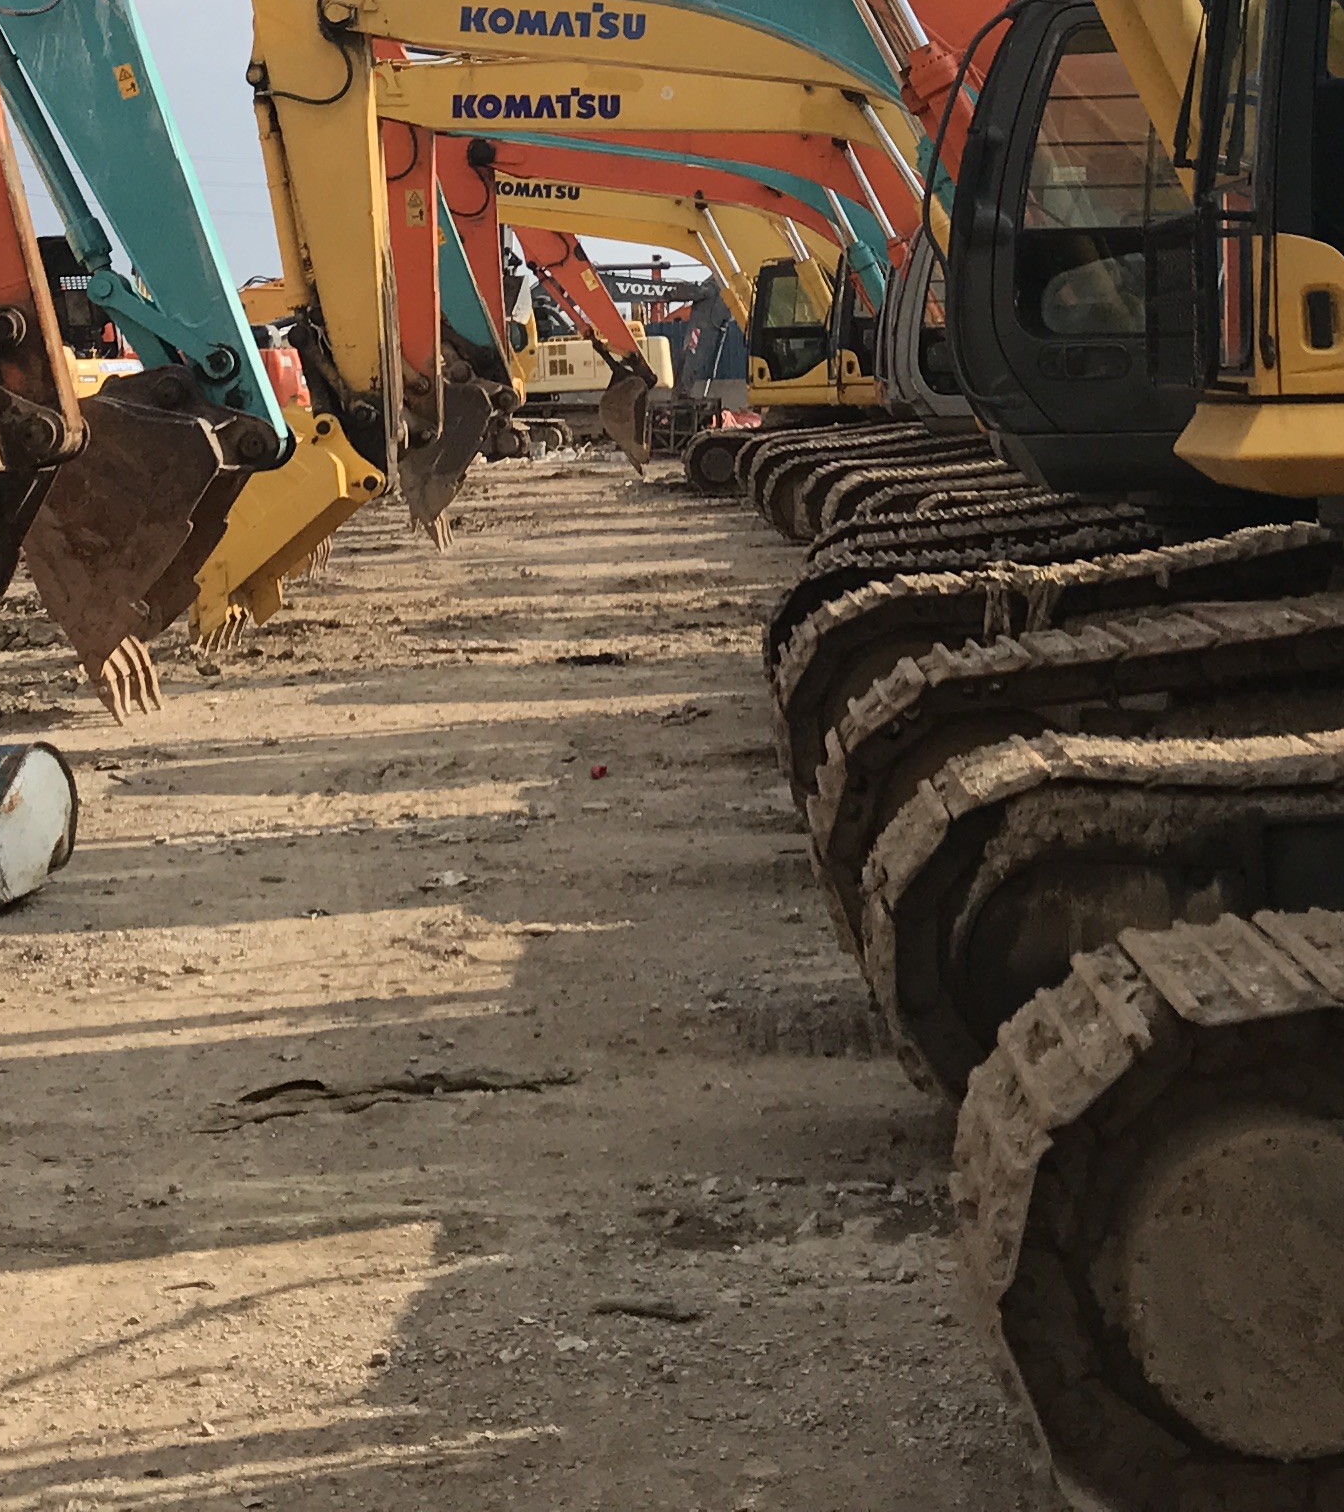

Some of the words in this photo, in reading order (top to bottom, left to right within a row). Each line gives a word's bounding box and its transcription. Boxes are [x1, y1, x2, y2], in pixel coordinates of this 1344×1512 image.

[460, 2, 646, 40] KOMATSU
[452, 87, 621, 119] KOMATSU
[615, 282, 677, 297] VOLV
